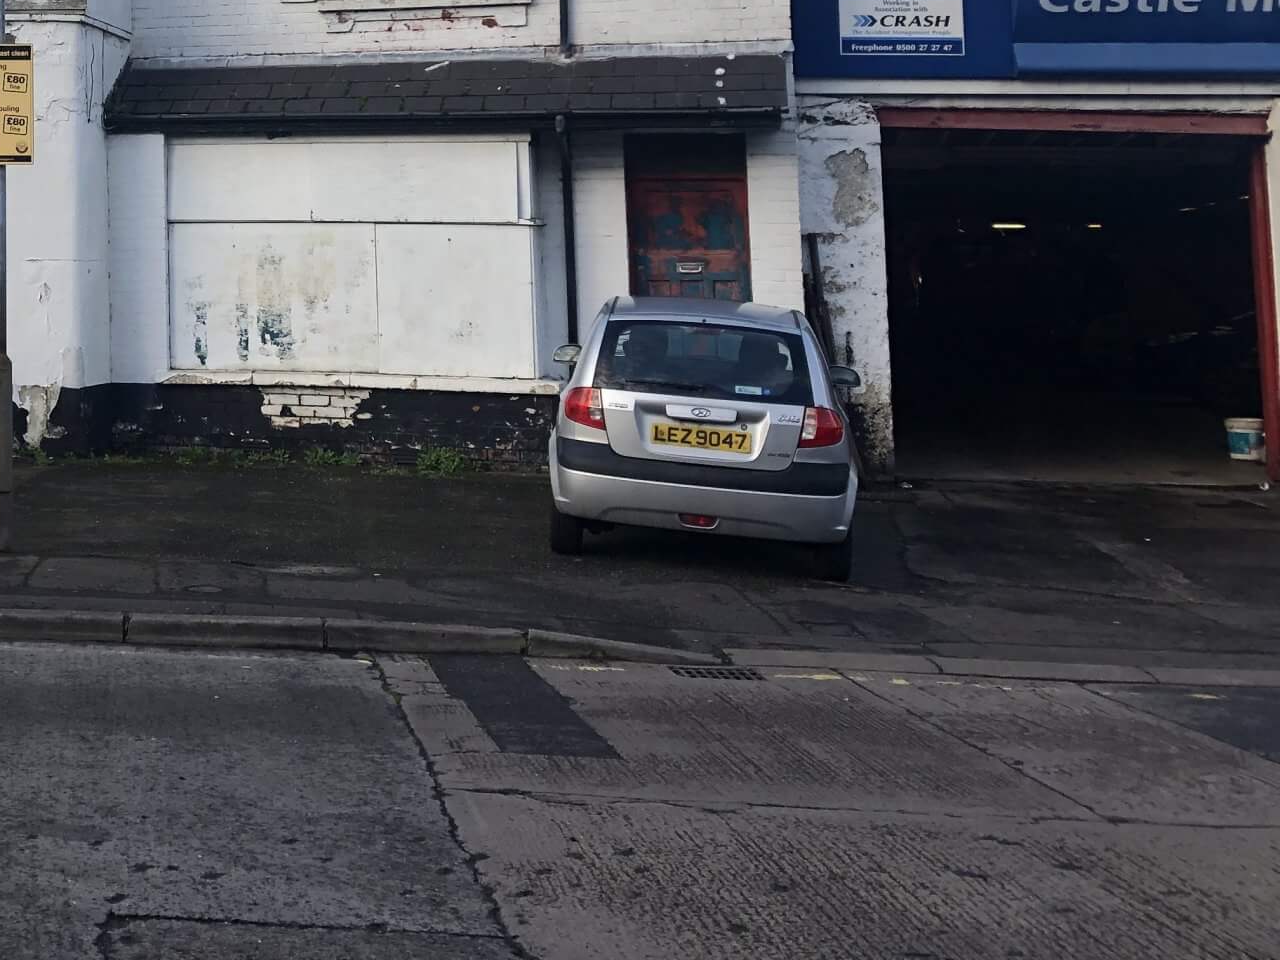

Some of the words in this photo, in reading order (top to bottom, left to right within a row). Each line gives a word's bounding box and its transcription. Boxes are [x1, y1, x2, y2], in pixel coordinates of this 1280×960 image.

[879, 14, 951, 28] CRASH
[851, 43, 894, 52] Freephone
[11, 49, 29, 57] clean
[6, 75, 26, 84] £80
[6, 117, 26, 126] £80
